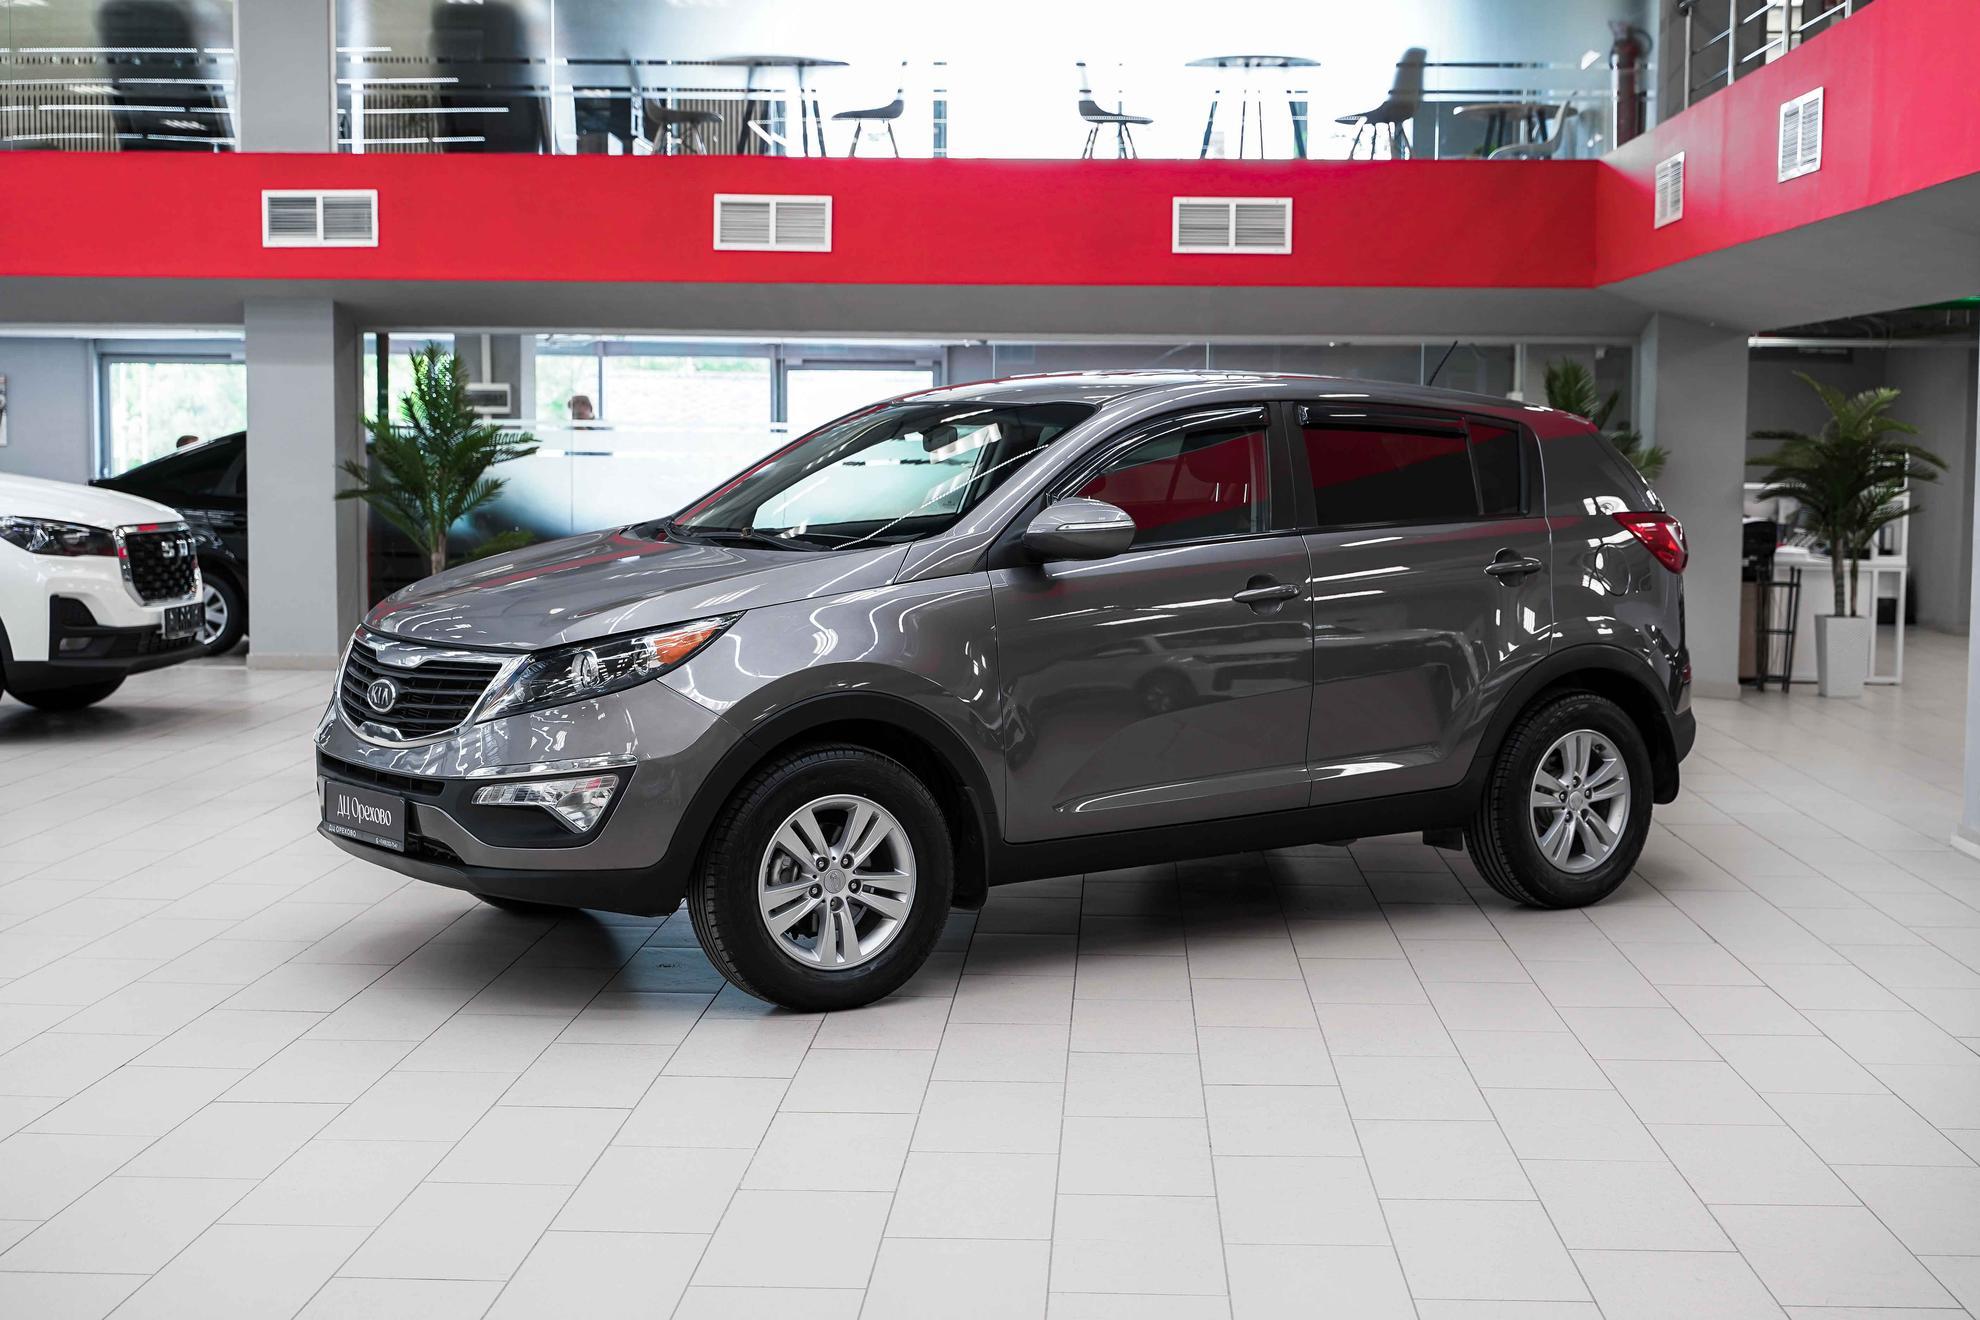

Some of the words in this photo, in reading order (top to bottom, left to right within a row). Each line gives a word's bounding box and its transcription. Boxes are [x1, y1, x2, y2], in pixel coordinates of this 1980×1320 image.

[370, 685, 389, 706] KIA
[337, 794, 351, 820] ДЦ
[351, 797, 392, 826] Орехово
